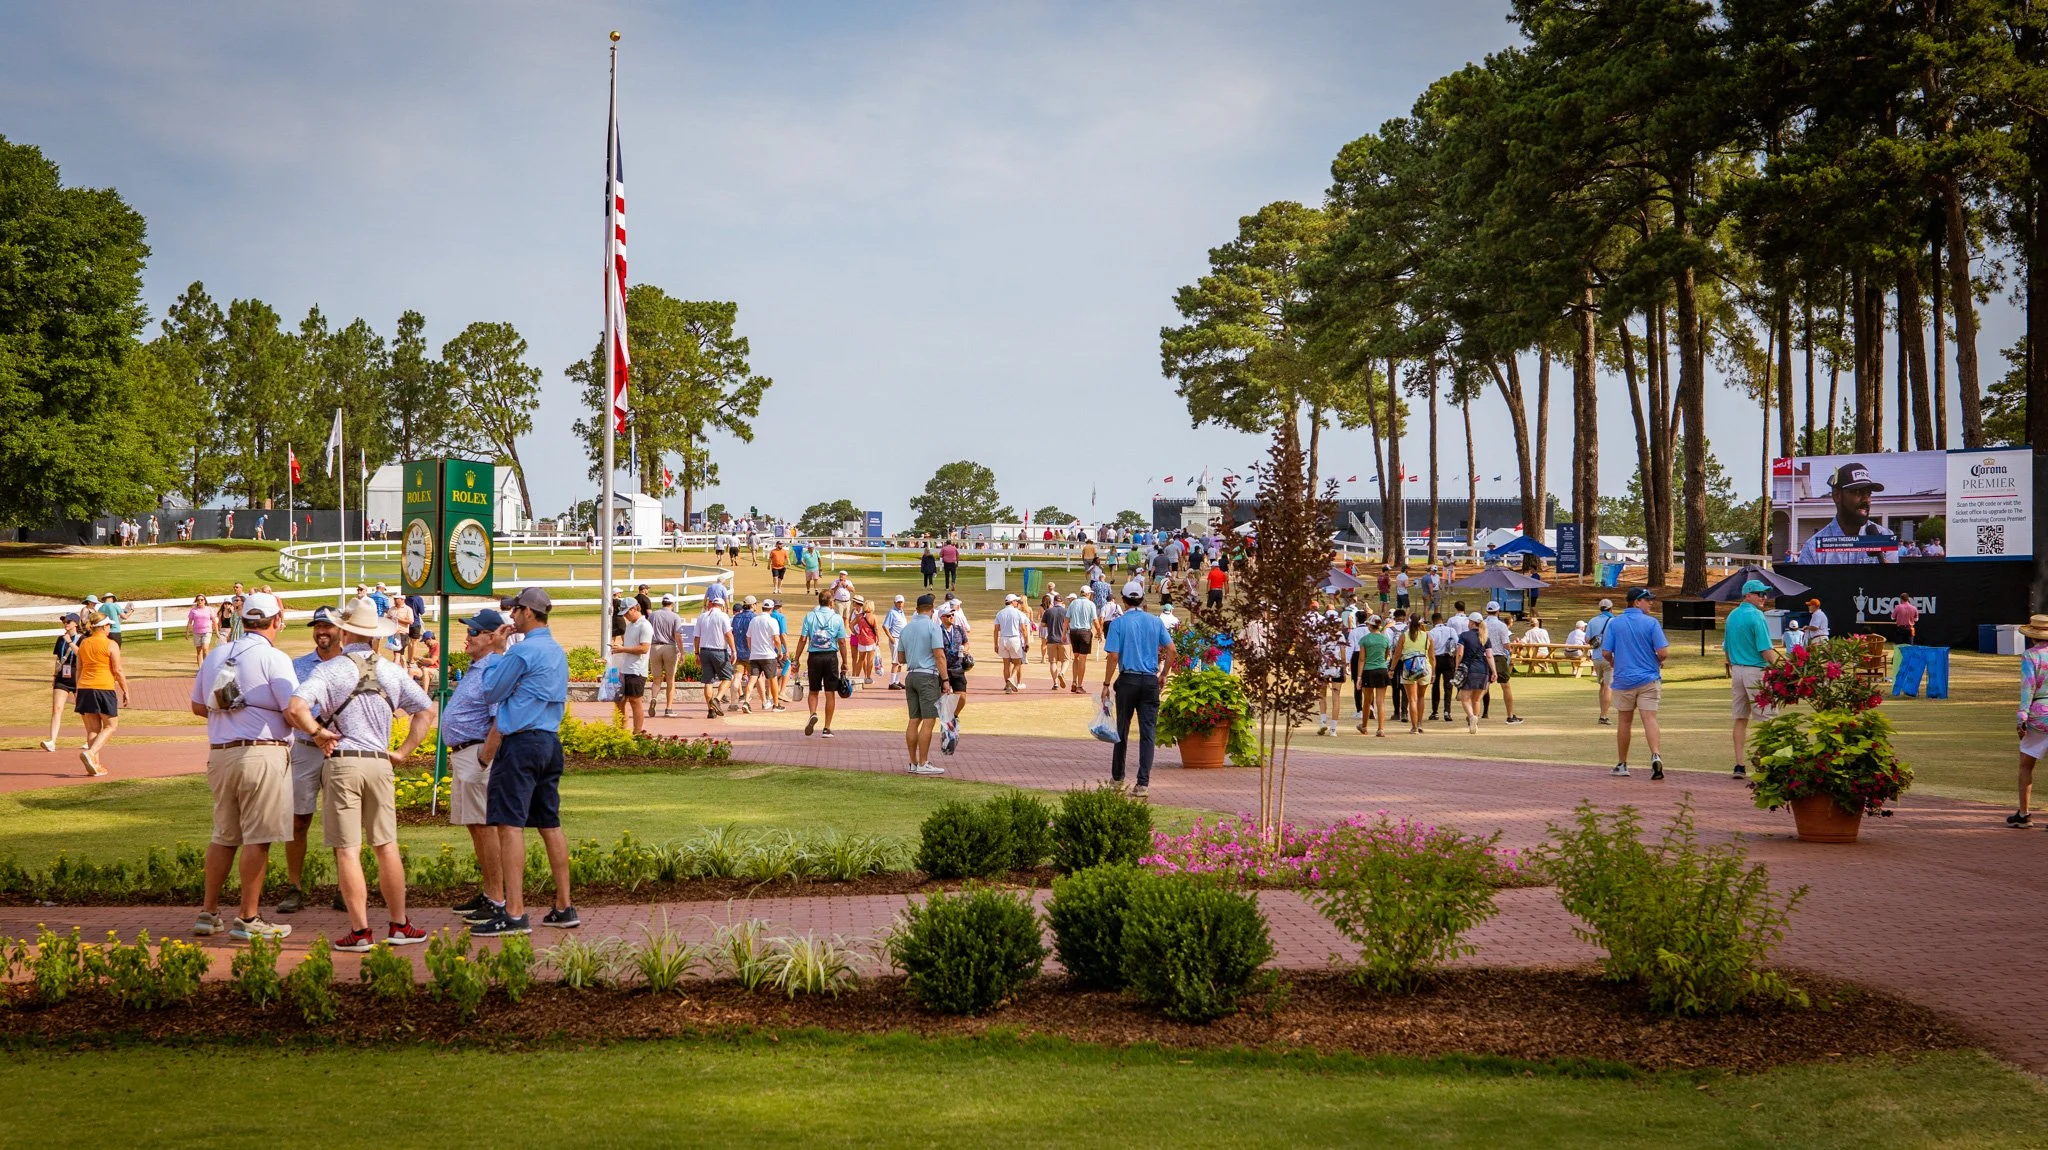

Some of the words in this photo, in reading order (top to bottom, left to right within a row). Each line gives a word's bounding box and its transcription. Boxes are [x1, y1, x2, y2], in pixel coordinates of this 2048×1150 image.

[1971, 465, 2007, 478] Corona
[1962, 478, 2015, 489] PREMIER
[407, 490, 432, 504] ROLEX
[452, 490, 487, 505] ROLEX
[1969, 516, 1989, 524] featuring
